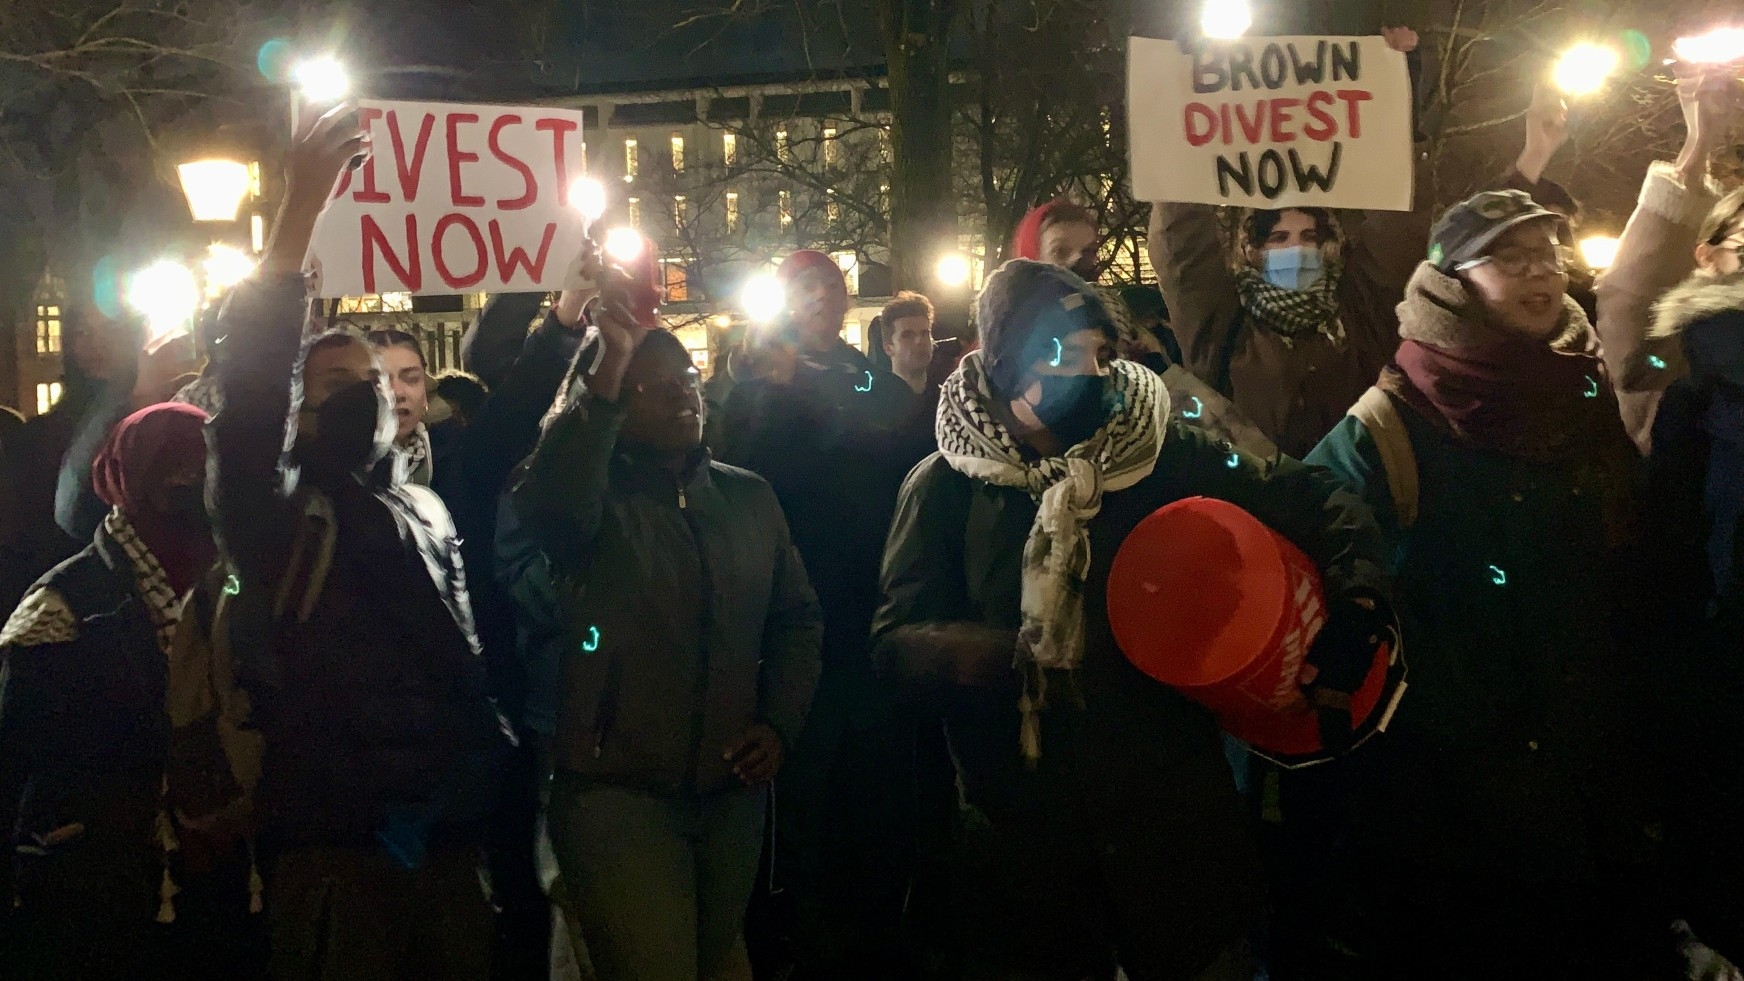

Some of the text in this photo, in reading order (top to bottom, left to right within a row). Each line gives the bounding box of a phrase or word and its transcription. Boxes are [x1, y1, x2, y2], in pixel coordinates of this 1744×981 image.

[1192, 40, 1360, 93] BROWN
[1184, 91, 1373, 146] DIVEST
[334, 107, 577, 210] IVEST
[1216, 142, 1343, 199] NOW
[361, 213, 557, 293] NOW
